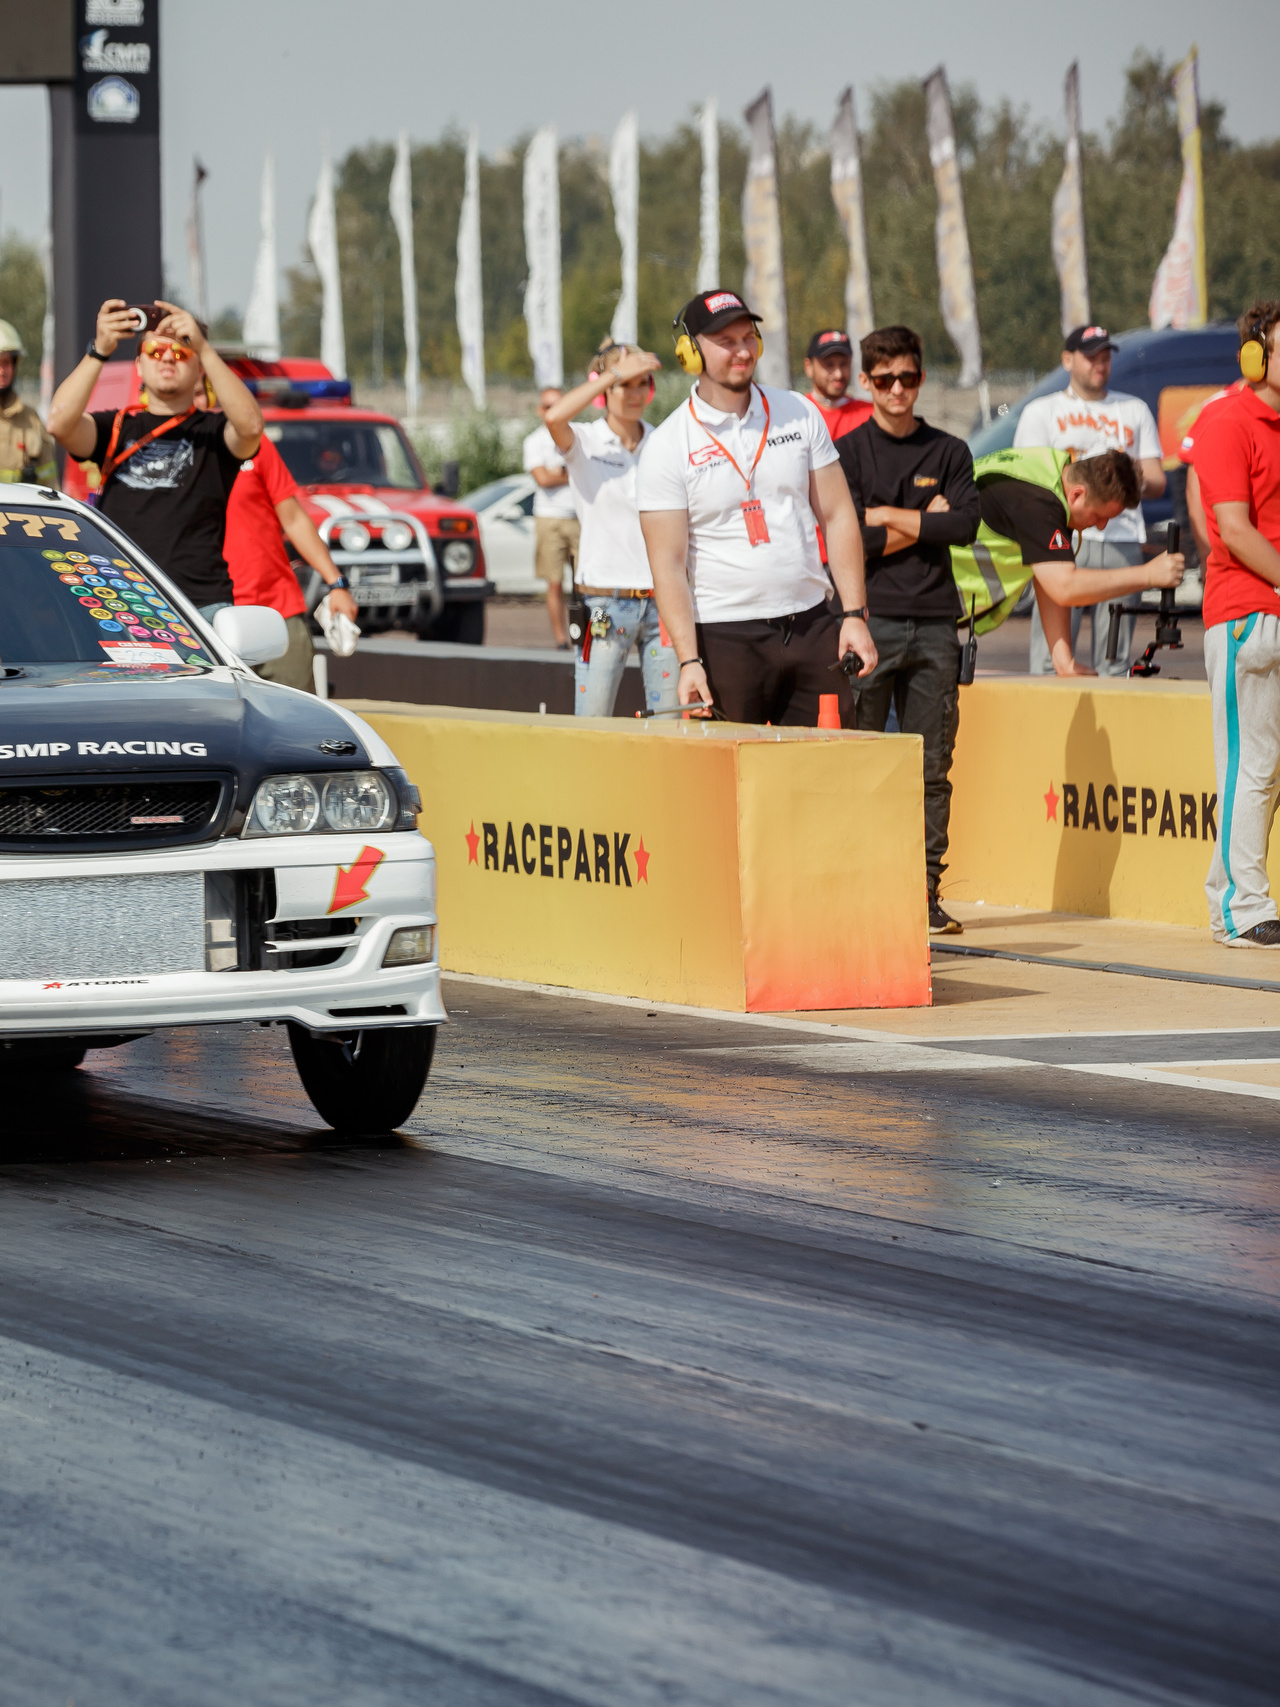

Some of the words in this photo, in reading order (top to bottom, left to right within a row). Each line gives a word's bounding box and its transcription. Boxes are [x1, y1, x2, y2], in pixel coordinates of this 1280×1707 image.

[77, 741, 208, 757] RACING
[1062, 781, 1218, 842] RACEPARK
[482, 821, 632, 887] RACEPARK
